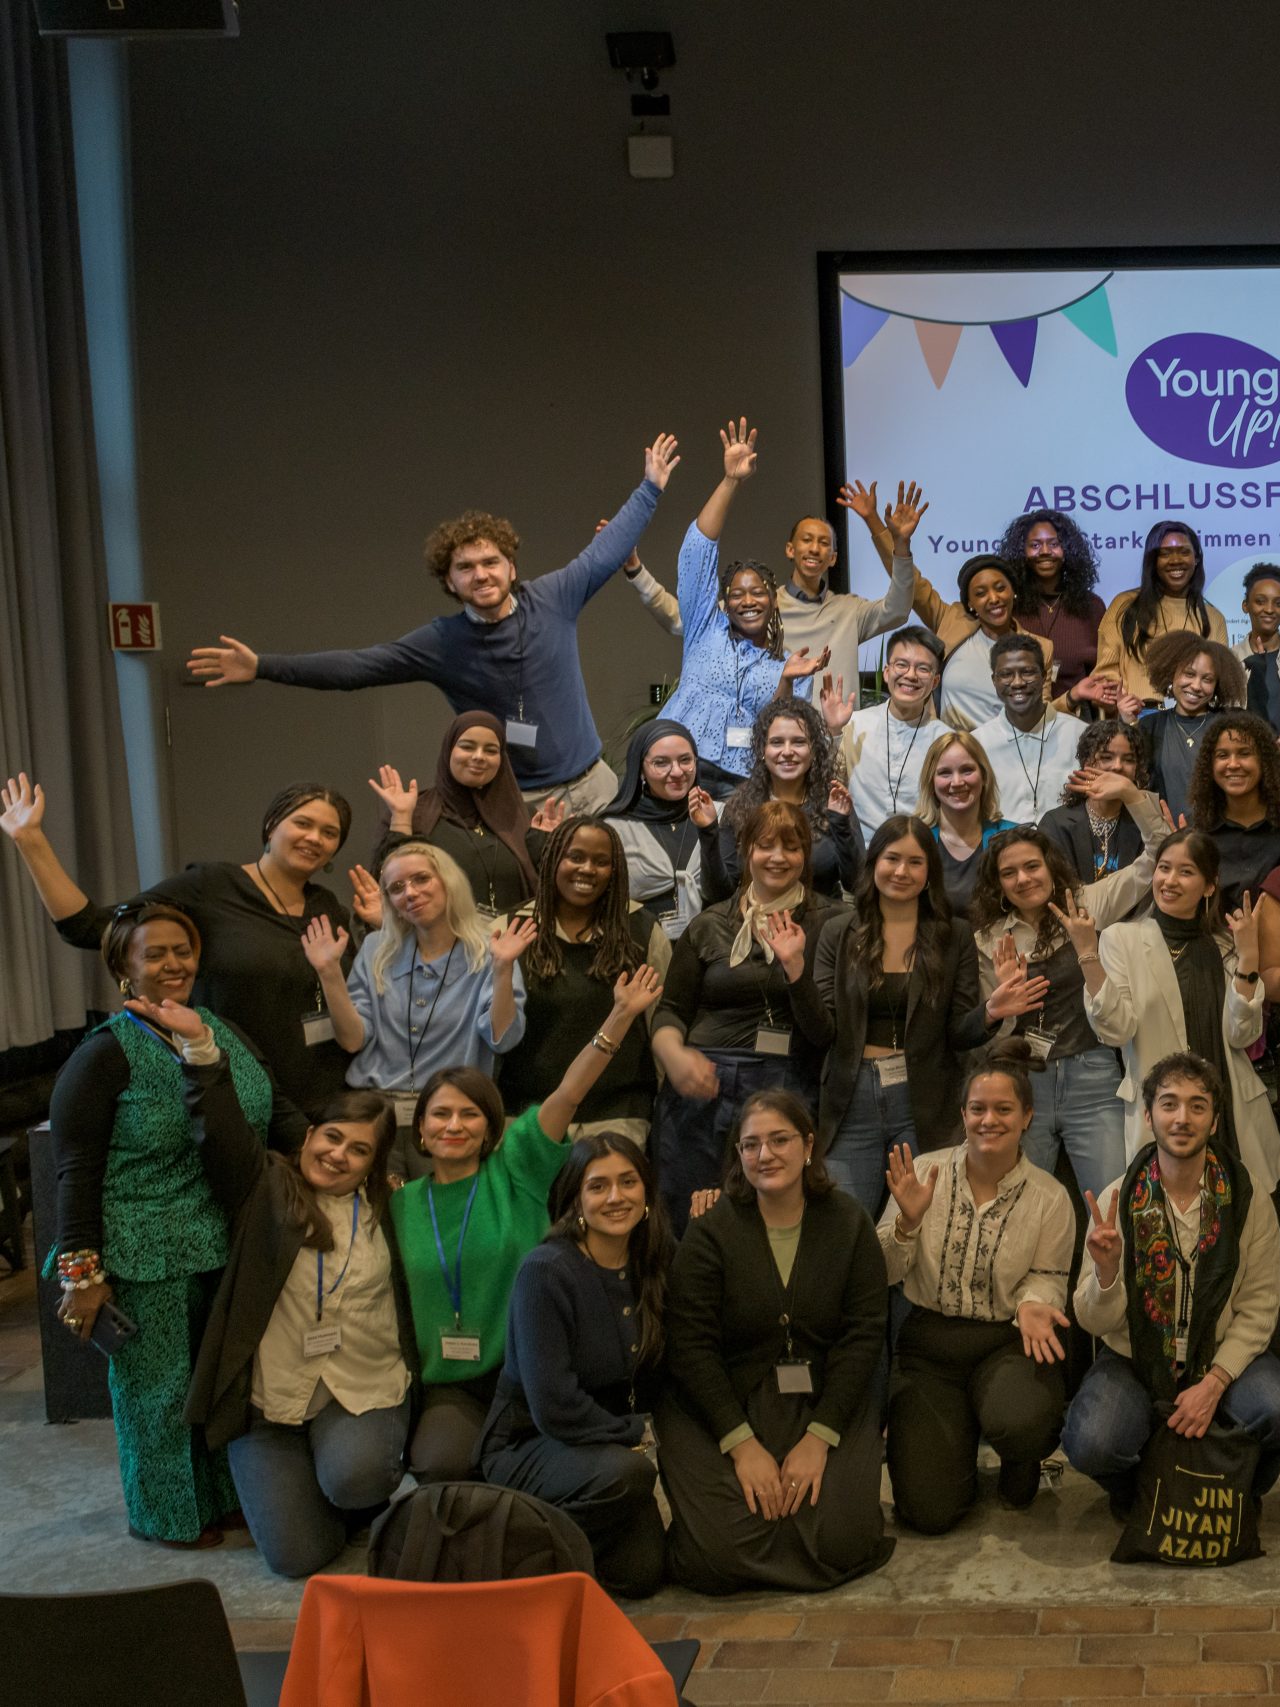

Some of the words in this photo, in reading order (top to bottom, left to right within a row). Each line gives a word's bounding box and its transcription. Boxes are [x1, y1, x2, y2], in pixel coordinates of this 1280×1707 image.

[1146, 358, 1278, 406] Young
[1197, 529, 1271, 547] immen
[1194, 1487, 1233, 1509] JIN
[1161, 1507, 1233, 1535] JIYAN
